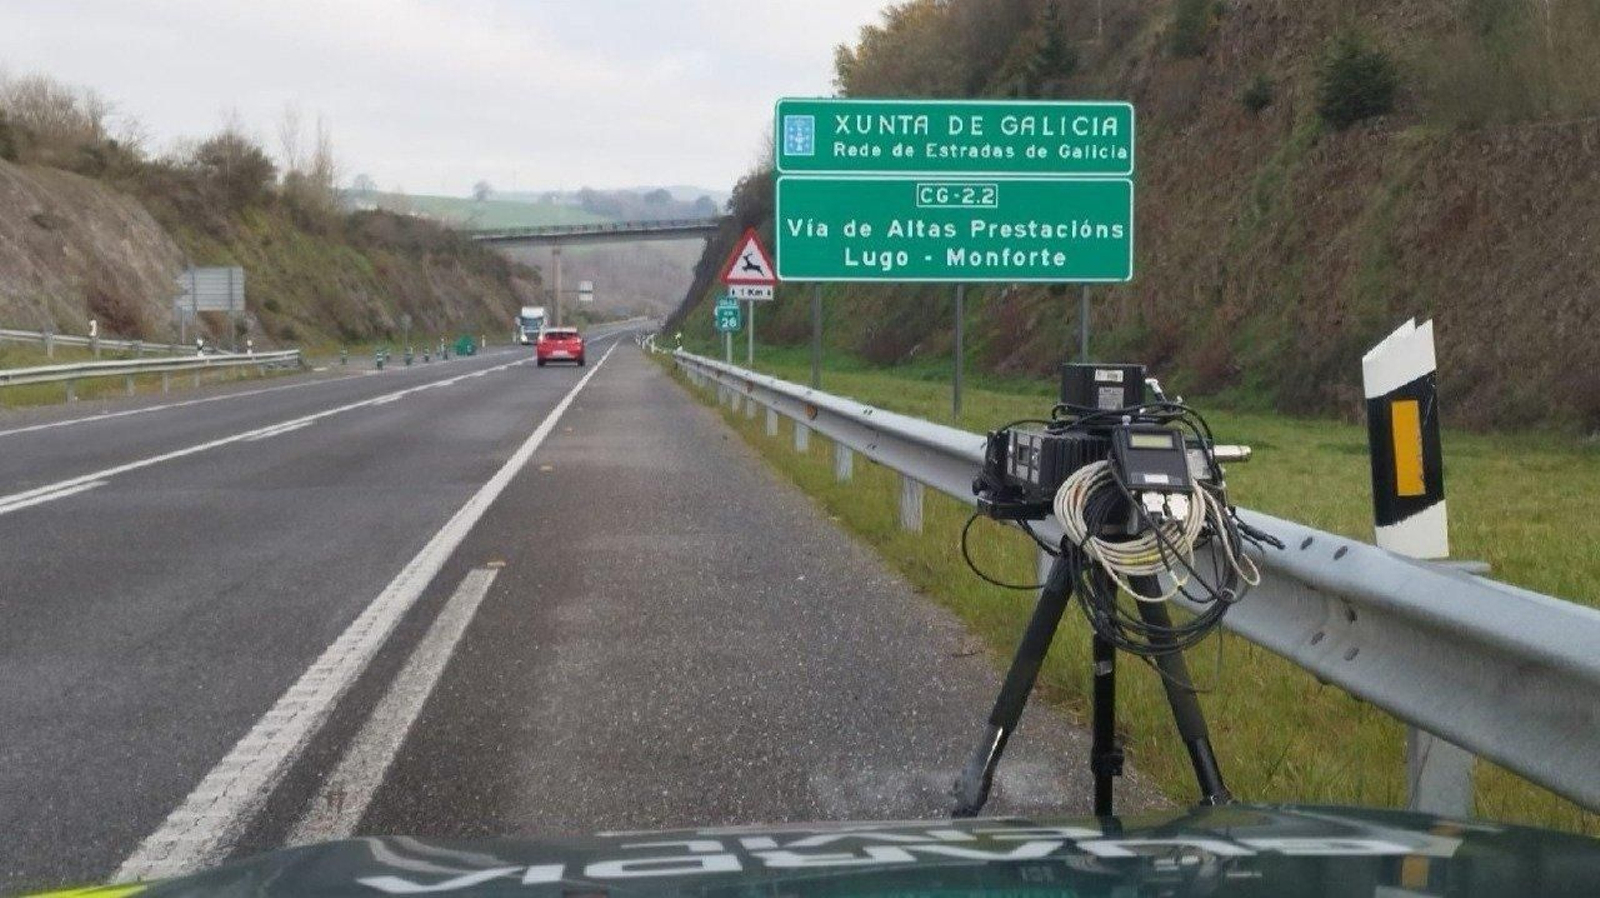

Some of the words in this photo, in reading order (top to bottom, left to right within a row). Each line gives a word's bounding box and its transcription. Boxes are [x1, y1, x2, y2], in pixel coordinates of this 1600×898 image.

[835, 115, 929, 136] XUNTA
[949, 116, 983, 136] DE
[1001, 116, 1119, 137] GALICIA
[834, 143, 881, 158] Rede
[892, 143, 914, 158] de
[926, 143, 1015, 159] Estradas
[1026, 144, 1047, 159] de
[1059, 145, 1128, 160] Galicia
[920, 187, 995, 205] CG-2.2
[787, 218, 829, 238] Vía
[843, 219, 872, 238] de
[888, 219, 957, 238] Altas
[971, 219, 1124, 239] Prestacións
[845, 248, 909, 271] Lugo
[946, 249, 1066, 266] Monforte
[620, 827, 1103, 851] CIVIL
[356, 837, 1414, 892] GUARDIA
